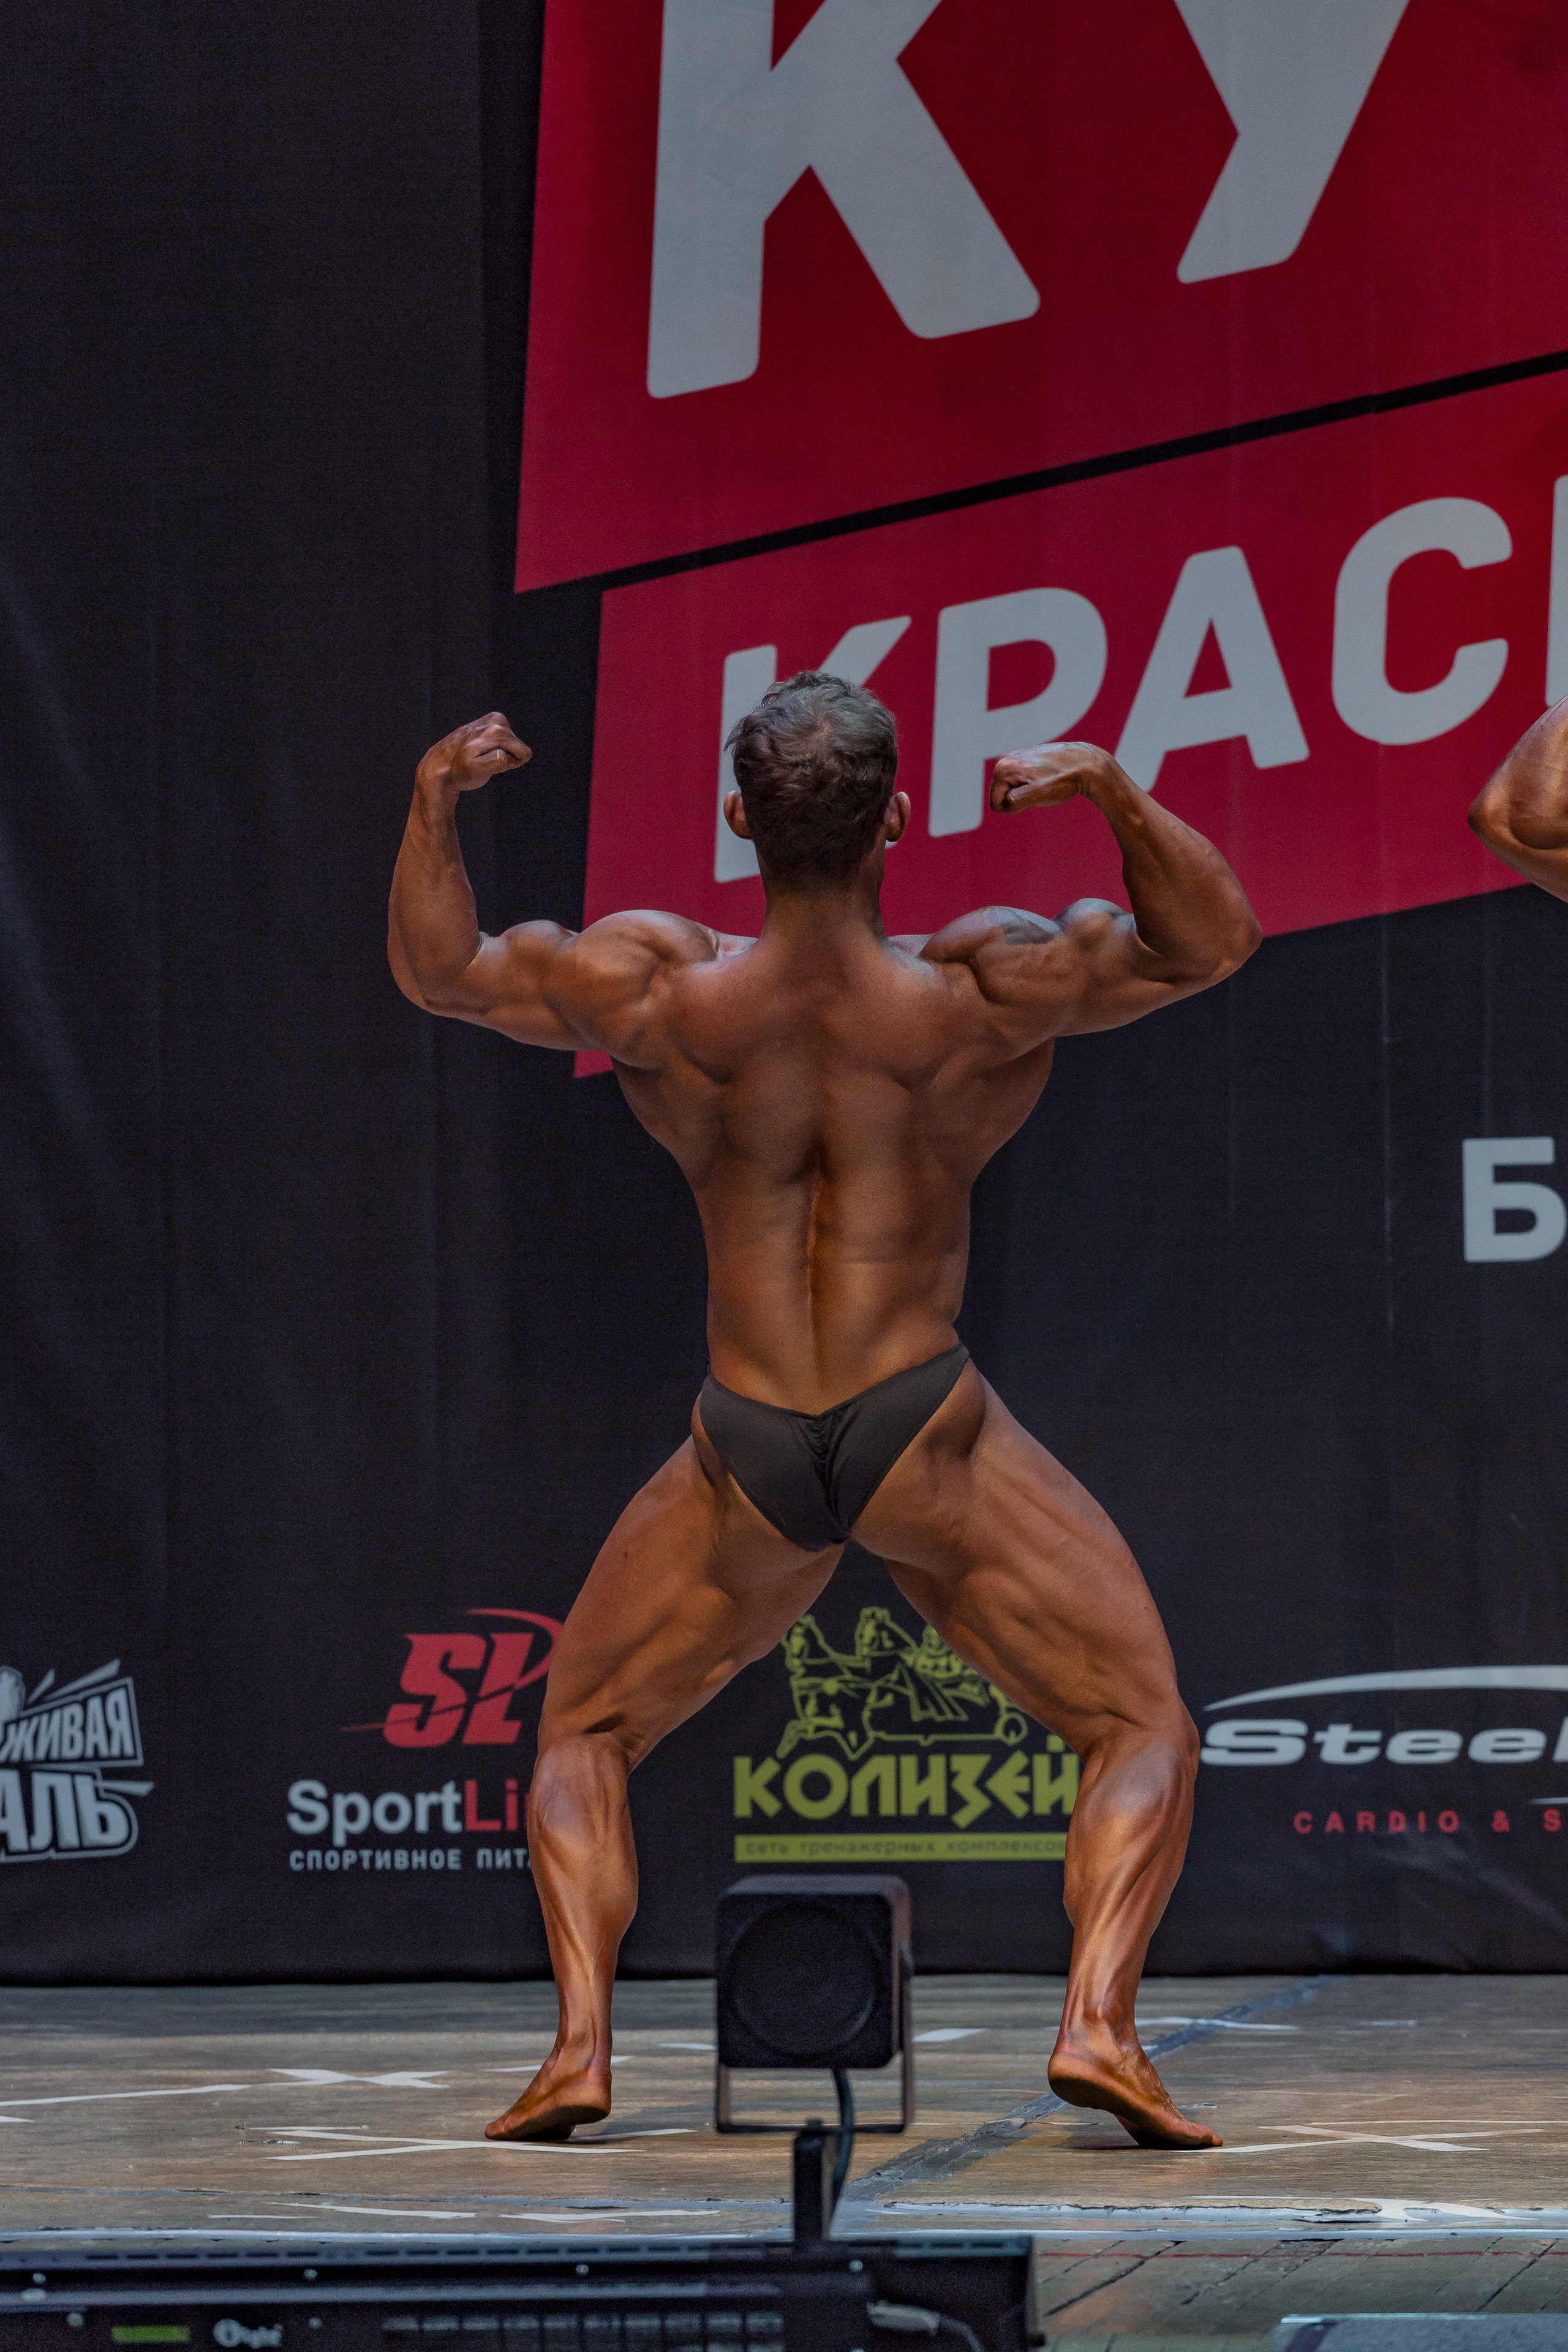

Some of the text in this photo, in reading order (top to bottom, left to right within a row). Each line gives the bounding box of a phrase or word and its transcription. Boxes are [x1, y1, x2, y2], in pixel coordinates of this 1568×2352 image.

[734, 1735, 1080, 1829] КОЛИЗЕЙ
[286, 1779, 530, 1847] SportLi
[1293, 1810, 1460, 1834] CARDIO
[1491, 1809, 1510, 1833] &
[289, 1849, 462, 1871] СПОРТИВНОЕ
